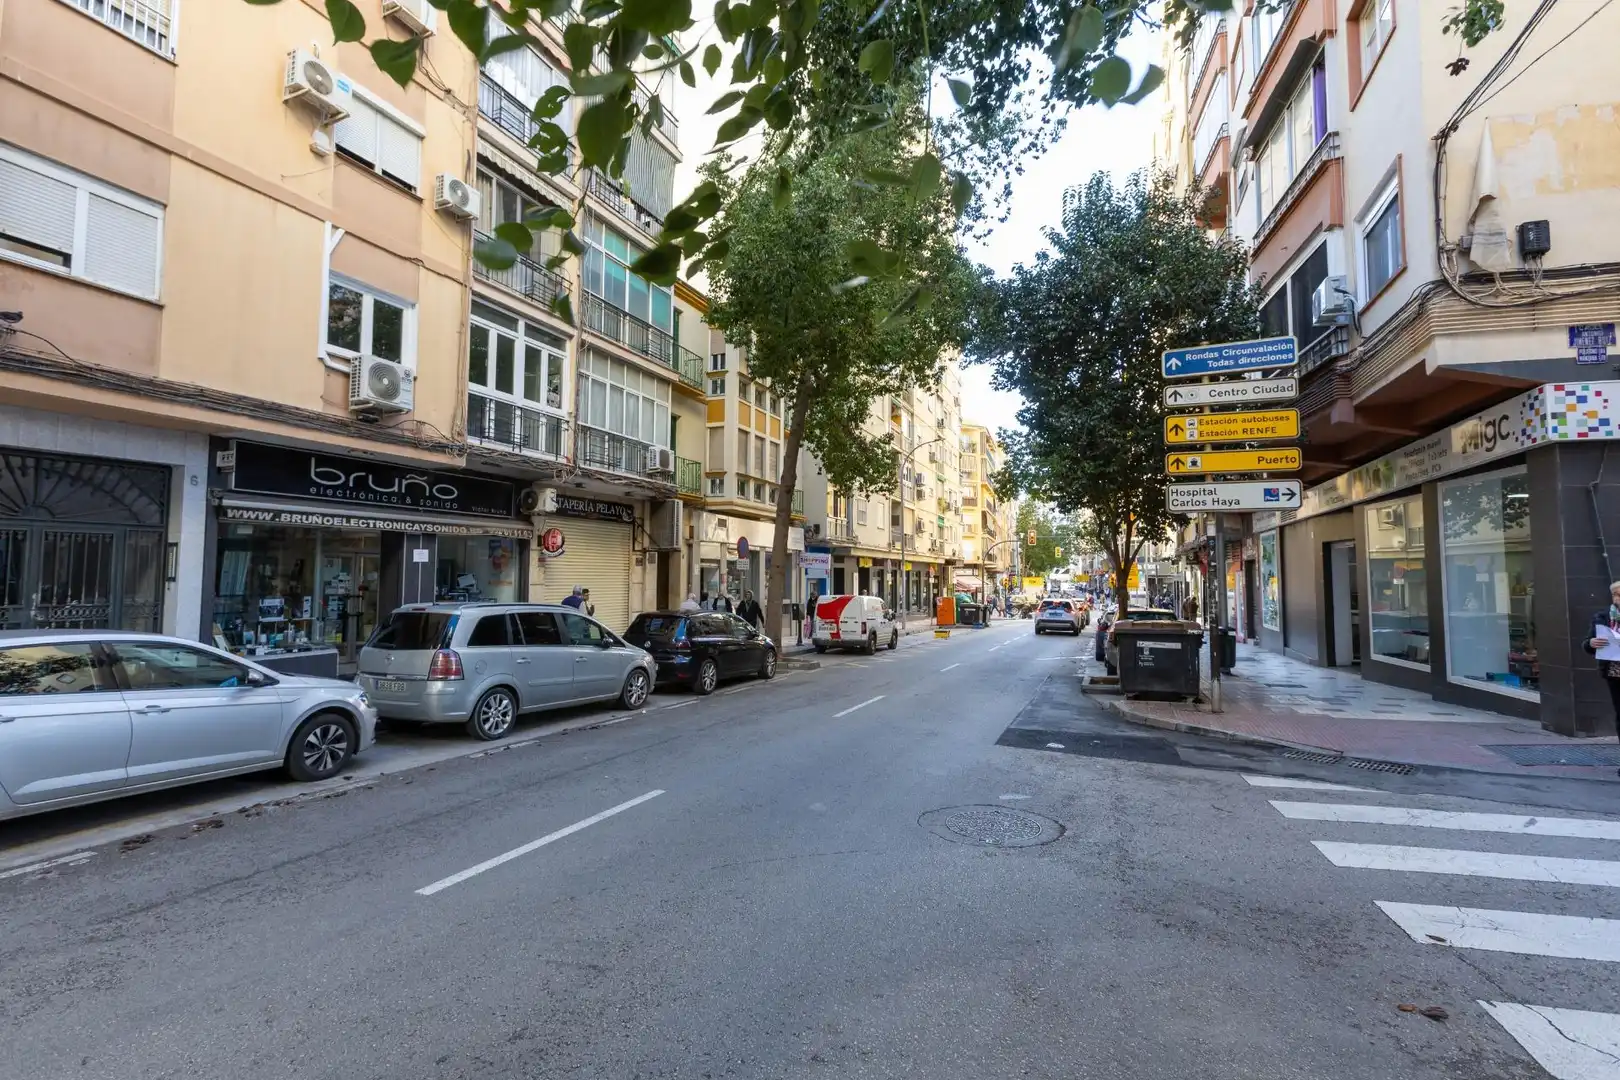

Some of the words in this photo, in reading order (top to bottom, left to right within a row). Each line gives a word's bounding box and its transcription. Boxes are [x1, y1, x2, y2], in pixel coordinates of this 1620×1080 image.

[1186, 349, 1219, 360] Rondas
[1222, 342, 1293, 357] Circunvalación
[1207, 359, 1234, 368] Todas
[1238, 352, 1293, 365] direcciones
[1208, 388, 1248, 398] Centro
[1252, 383, 1294, 395] Ciudad
[1199, 417, 1238, 426] Estación
[1241, 414, 1290, 424] autobuses
[1199, 428, 1239, 438] Estación
[1242, 426, 1277, 436] RENFE
[1257, 455, 1297, 465] Puerto
[190, 474, 199, 487] 6
[310, 456, 459, 499] bruño
[309, 486, 398, 504] electrónica
[419, 498, 459, 509] sonido
[1170, 487, 1218, 498] Hospital
[1171, 498, 1208, 508] Carlos
[1211, 497, 1241, 507] Haya
[596, 503, 626, 516] PELAYO
